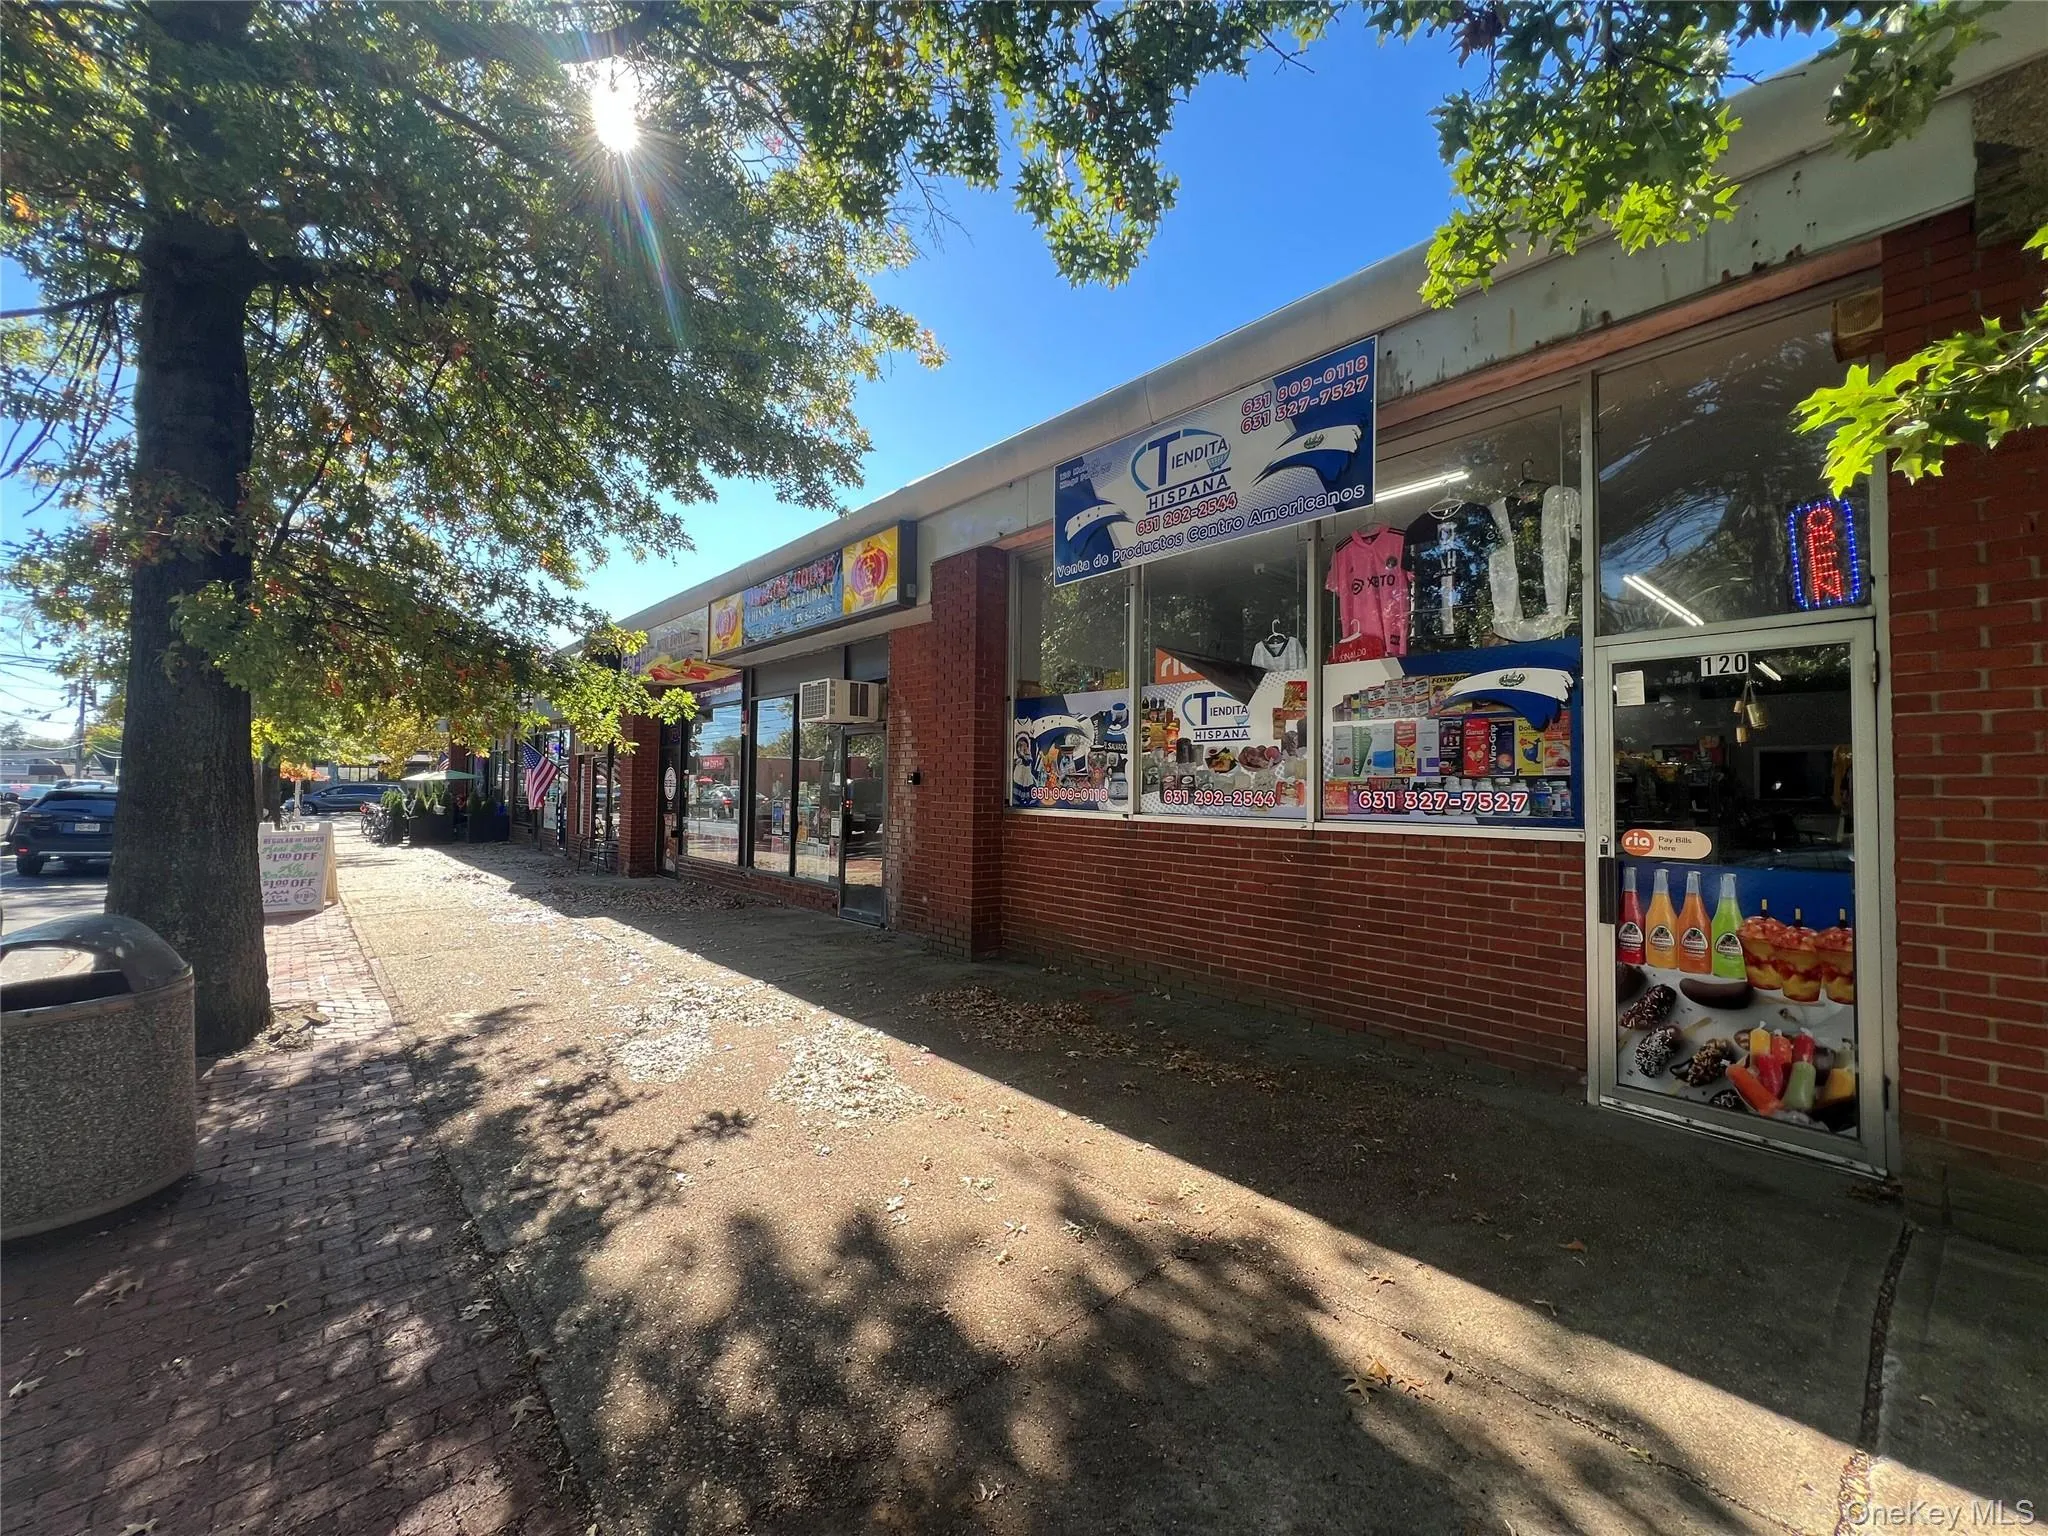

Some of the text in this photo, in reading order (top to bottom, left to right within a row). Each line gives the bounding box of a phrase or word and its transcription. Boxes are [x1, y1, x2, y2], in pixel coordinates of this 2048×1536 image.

[1242, 355, 1369, 417] 631 809-0118
[1241, 375, 1369, 434] 631 327-7527
[1148, 430, 1228, 487] TIENDITA
[1149, 474, 1228, 510] HISPANA
[1136, 492, 1238, 537] 631 292-2544
[1056, 484, 1366, 578] Venta de Productos Centro Americanos
[1806, 506, 1843, 606] OPEN
[1703, 654, 1747, 675] 120
[1193, 691, 1248, 725] TIENDITA
[1195, 729, 1248, 739] HISPANA
[1031, 787, 1108, 802] 631 809-0118
[1164, 790, 1276, 807] 631 292-2544
[1358, 791, 1396, 810] 631
[1404, 791, 1528, 813] 327-7527
[1625, 832, 1651, 846] ria
[1658, 836, 1674, 844] Pay
[293, 852, 319, 861] OFF
[291, 879, 316, 888] OFF
